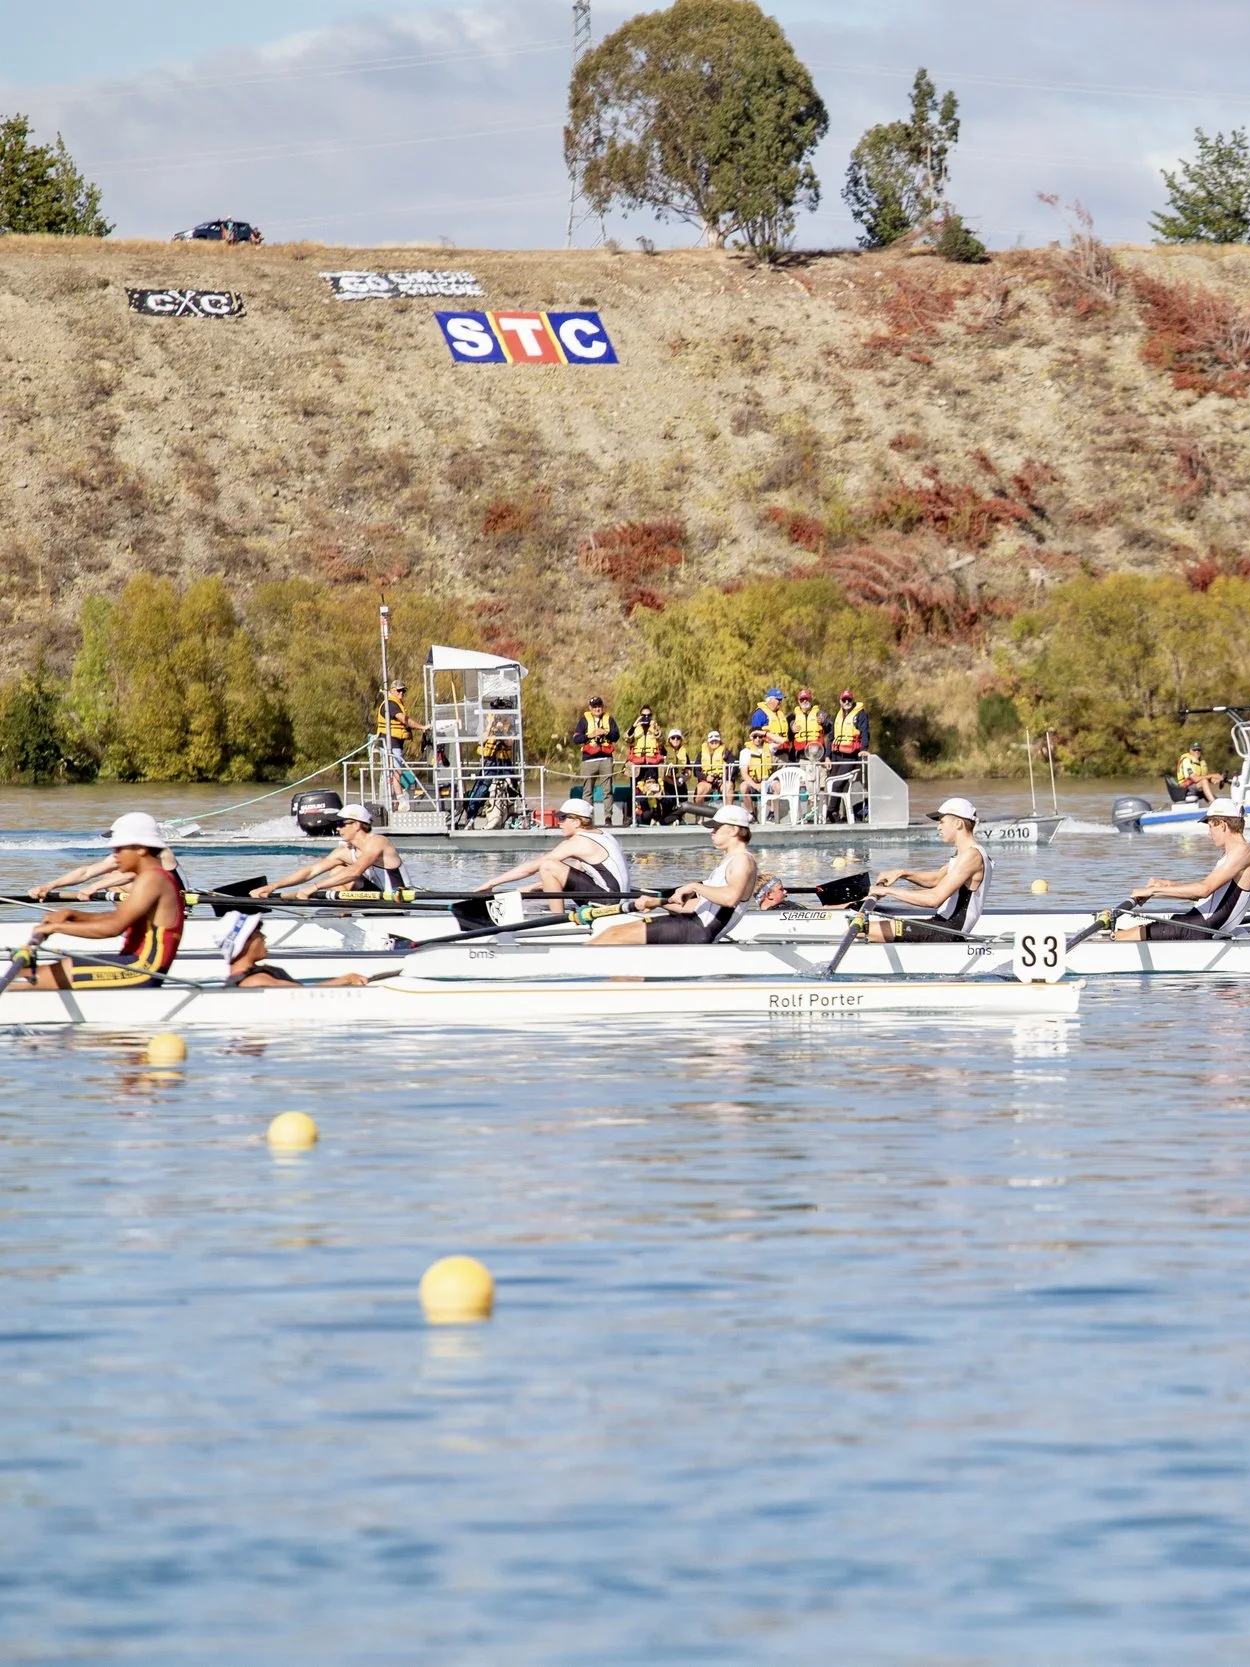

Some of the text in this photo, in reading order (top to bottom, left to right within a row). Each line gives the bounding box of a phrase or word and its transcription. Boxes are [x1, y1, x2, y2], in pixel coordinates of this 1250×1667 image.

[446, 317, 607, 359] STC
[1000, 827, 1030, 839] 2010
[769, 993, 864, 1007] Rolf Porter
